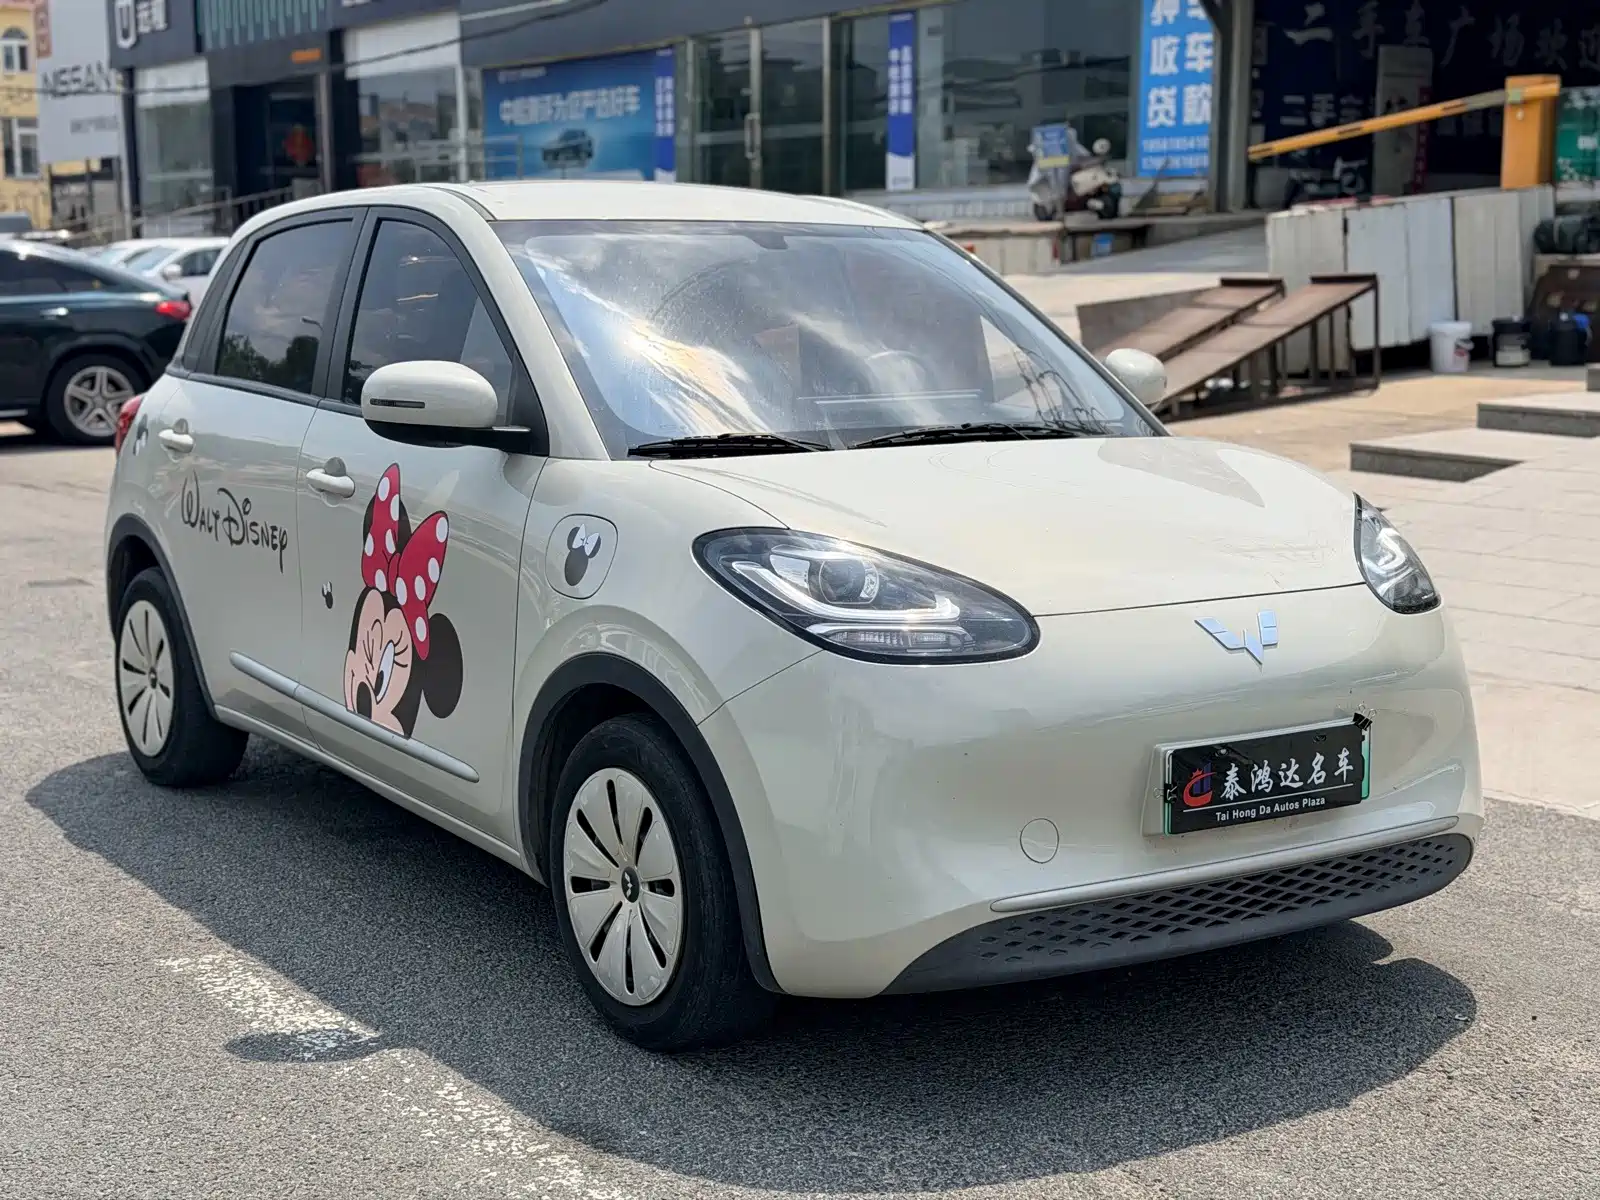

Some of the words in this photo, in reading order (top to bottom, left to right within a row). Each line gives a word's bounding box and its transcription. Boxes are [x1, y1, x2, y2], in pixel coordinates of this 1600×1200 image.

[1150, 32, 1214, 76] 收车
[41, 60, 112, 98] NISSAN
[1147, 82, 1212, 128] 贷款
[1220, 747, 1354, 801] 泰鸿达名车
[1215, 811, 1230, 822] Tai
[1232, 808, 1257, 820] Hong
[1259, 804, 1271, 815] Da
[1273, 800, 1300, 813] Autos
[1302, 796, 1326, 808] Plaza
